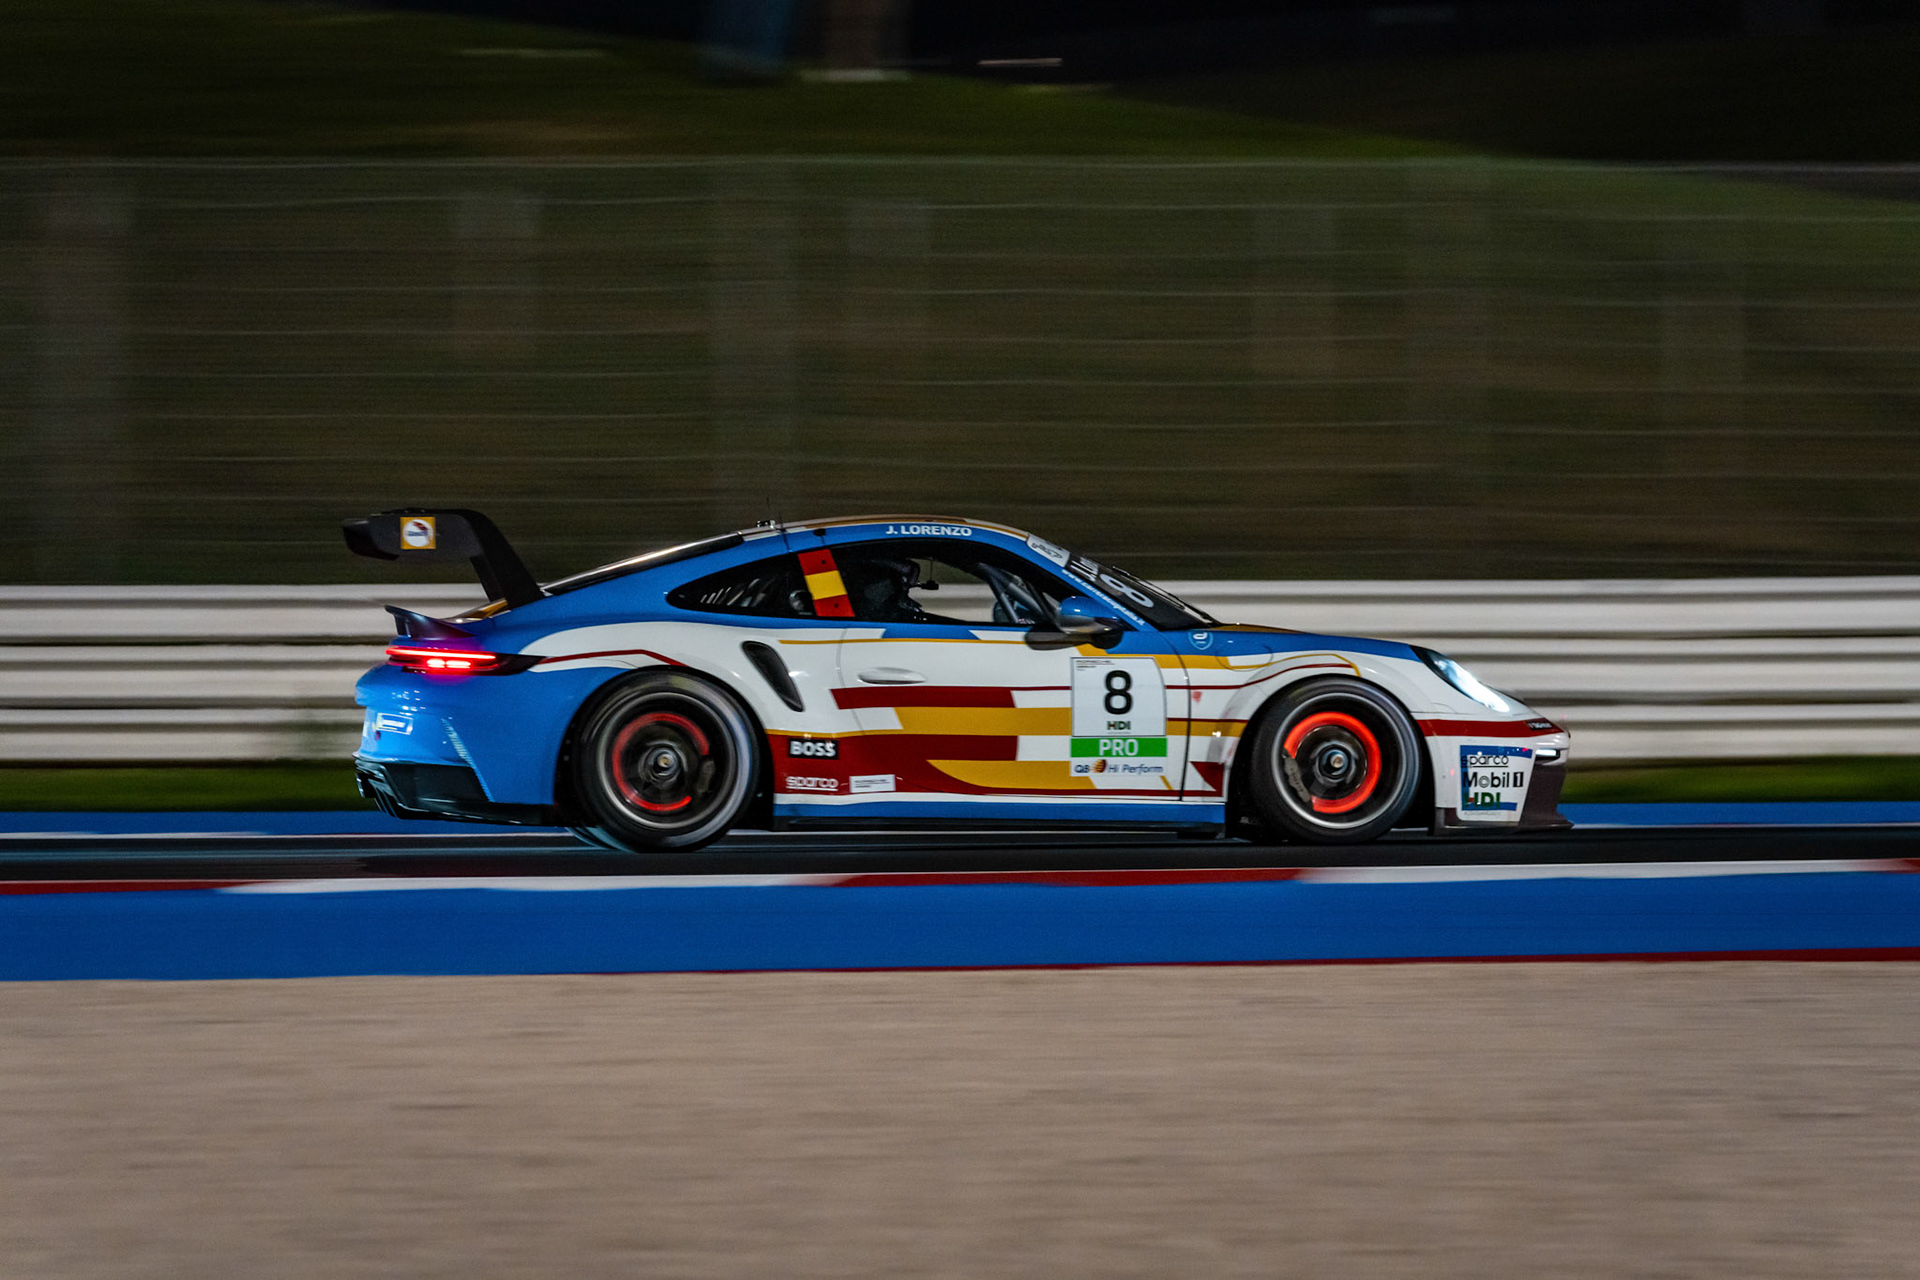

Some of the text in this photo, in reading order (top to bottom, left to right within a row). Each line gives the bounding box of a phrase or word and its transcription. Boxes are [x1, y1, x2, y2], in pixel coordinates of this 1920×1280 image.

[885, 525, 972, 537] J. LORENZO
[1099, 573, 1155, 608] 8
[1104, 670, 1133, 715] 8
[1107, 721, 1131, 730] HDI
[790, 741, 836, 757] BOSS
[1099, 739, 1139, 756] PRO
[1107, 764, 1119, 773] Hi
[1121, 763, 1163, 776] Perform
[1461, 755, 1509, 768] sparco
[785, 776, 839, 791] sparco
[1463, 771, 1524, 788] Mobil 1
[1464, 792, 1501, 808] HDI
